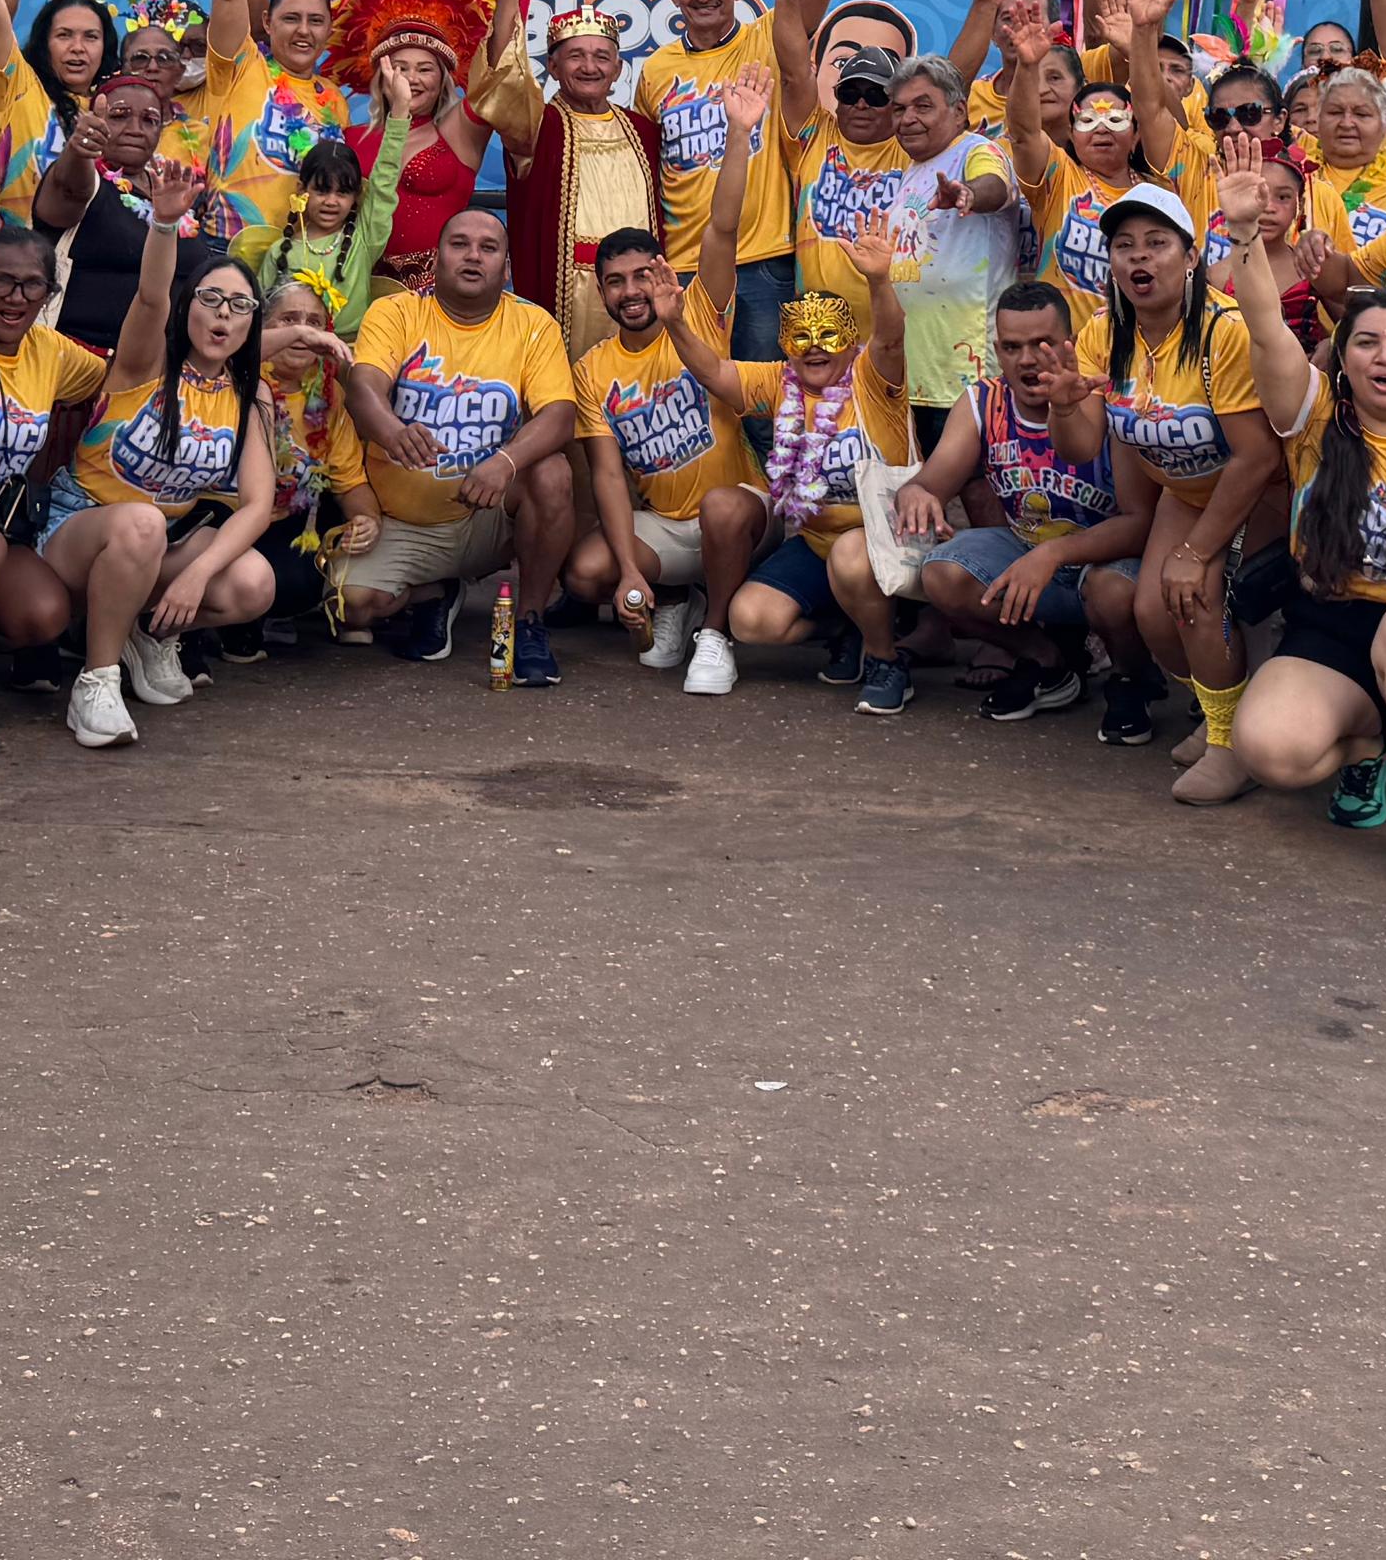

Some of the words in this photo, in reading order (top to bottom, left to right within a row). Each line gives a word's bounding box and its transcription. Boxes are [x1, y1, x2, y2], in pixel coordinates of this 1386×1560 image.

[396, 386, 510, 423] BLOCO
[129, 413, 232, 468] BOCO
[432, 425, 503, 452] OSO
